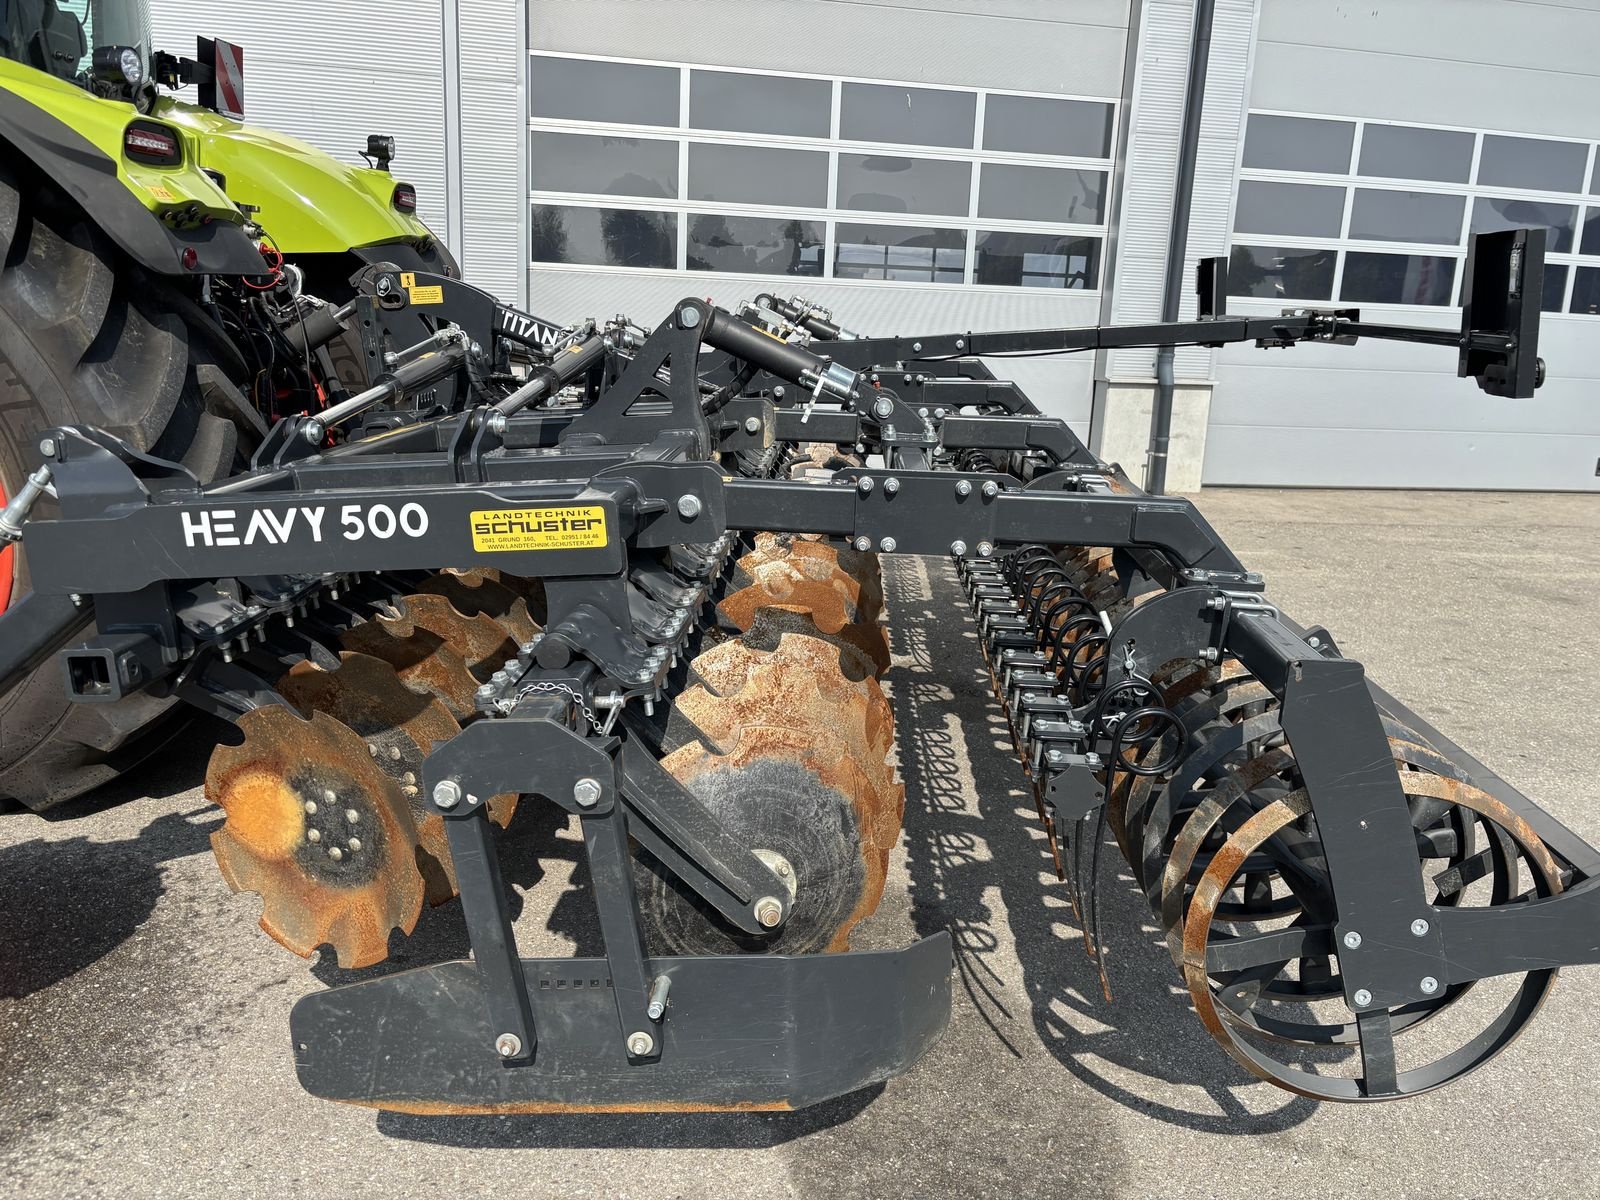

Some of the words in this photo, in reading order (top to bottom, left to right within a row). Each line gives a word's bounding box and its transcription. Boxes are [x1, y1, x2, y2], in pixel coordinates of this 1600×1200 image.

[502, 310, 559, 347] TITAN
[483, 510, 591, 520] LANDTECHNIK
[181, 507, 325, 547] HEAVY
[340, 503, 428, 542] 500
[475, 518, 601, 534] schuster
[488, 540, 594, 550] WWW.LANDTECHNIK-SCHUSTER.AT
